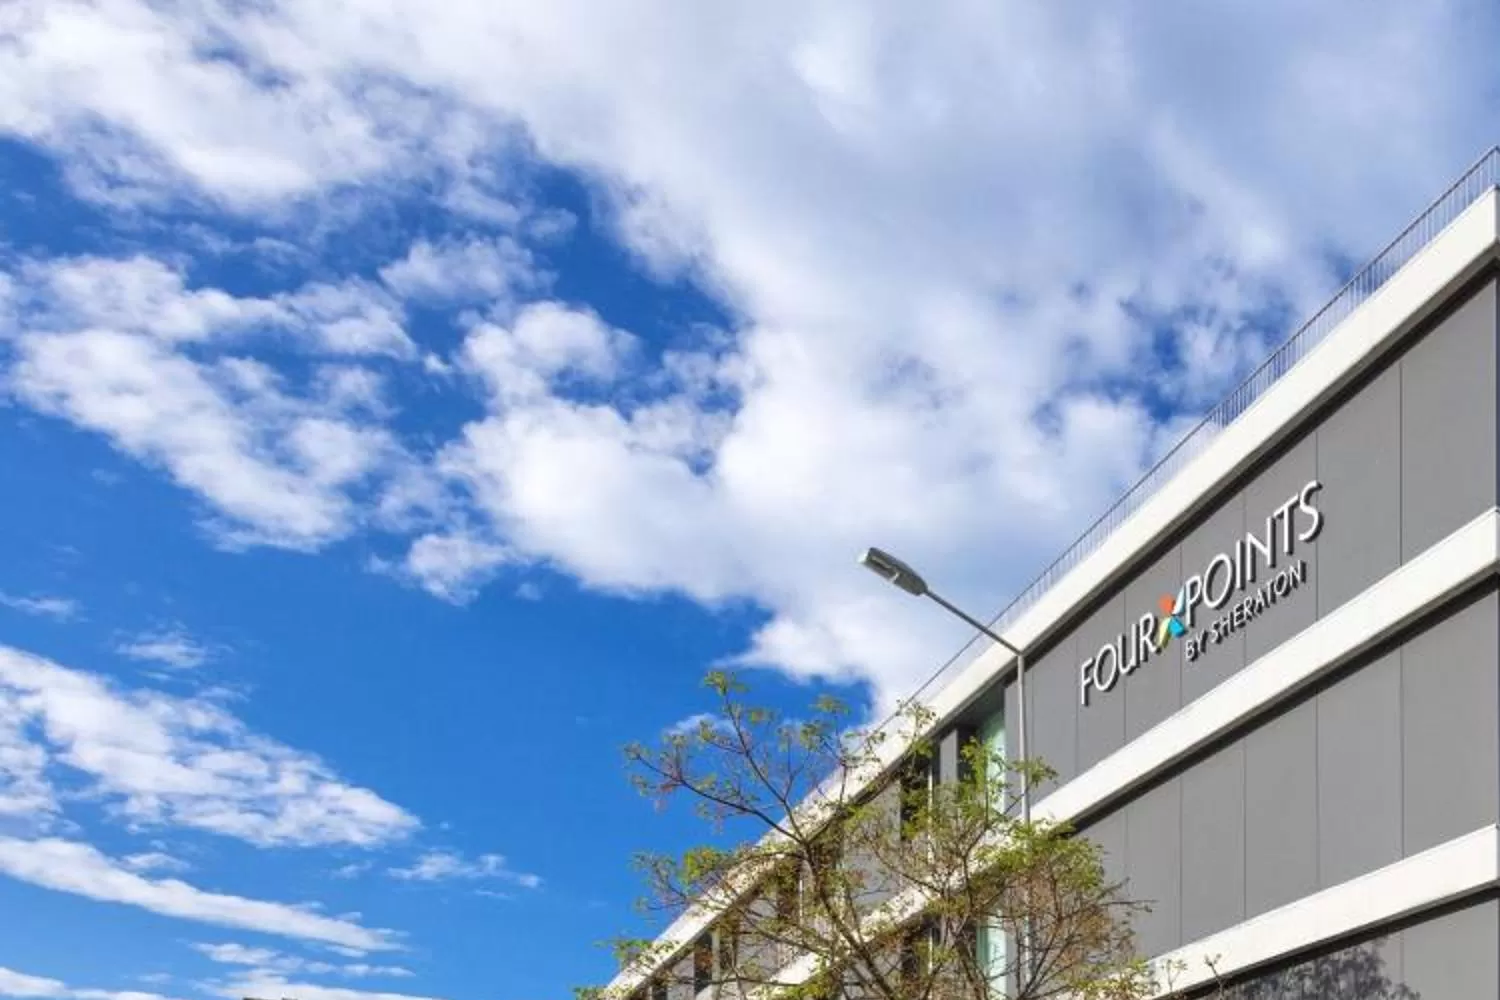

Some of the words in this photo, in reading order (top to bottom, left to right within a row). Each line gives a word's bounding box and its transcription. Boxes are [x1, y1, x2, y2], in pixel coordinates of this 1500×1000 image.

[1080, 611, 1160, 705] FOUR
[1184, 480, 1322, 627] POINTS
[1185, 629, 1208, 662] BY
[1211, 560, 1306, 644] SHERATON
